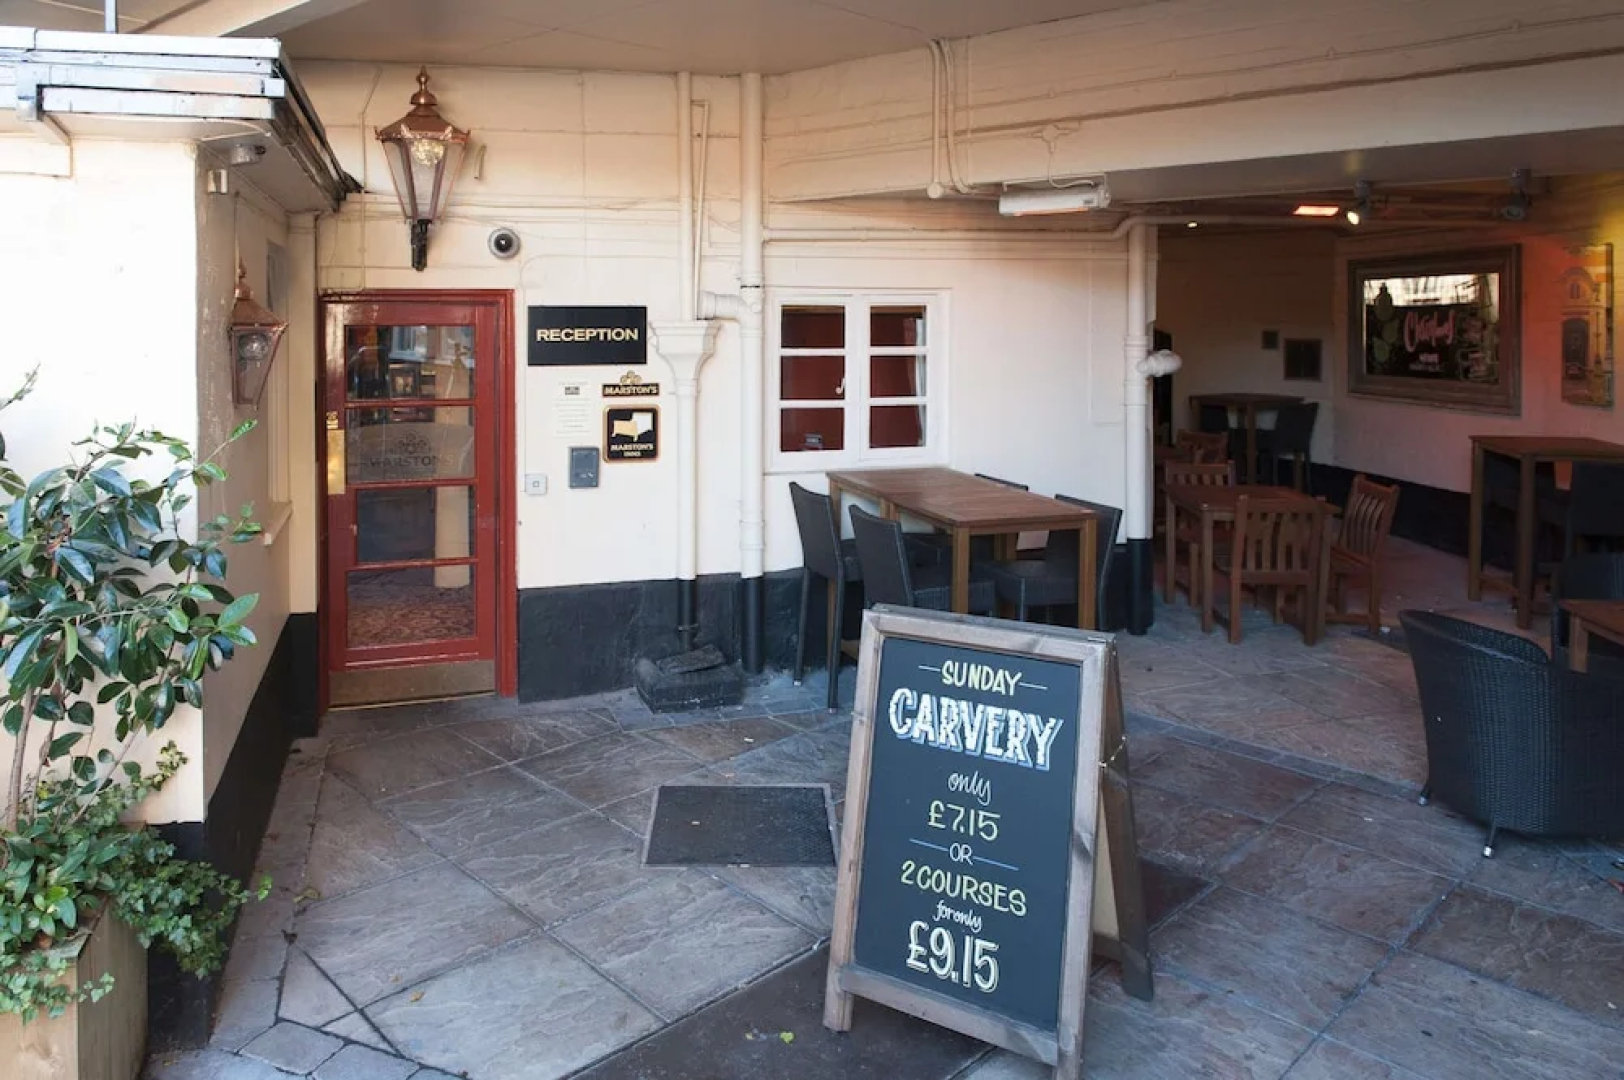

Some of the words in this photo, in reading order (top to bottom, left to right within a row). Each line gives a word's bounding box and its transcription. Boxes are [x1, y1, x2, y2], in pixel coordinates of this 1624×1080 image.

[536, 328, 639, 342] RECEPTION
[604, 386, 658, 395] MARSTON'S
[941, 660, 1022, 696] SUNDAY
[889, 688, 1064, 771] CARVERY
[948, 770, 991, 805] only
[928, 800, 1001, 840] £7.15
[949, 843, 973, 865] OR
[916, 865, 1027, 916] COURSES
[933, 900, 953, 922] for
[954, 906, 982, 933] only
[906, 920, 1000, 993] £9.15
